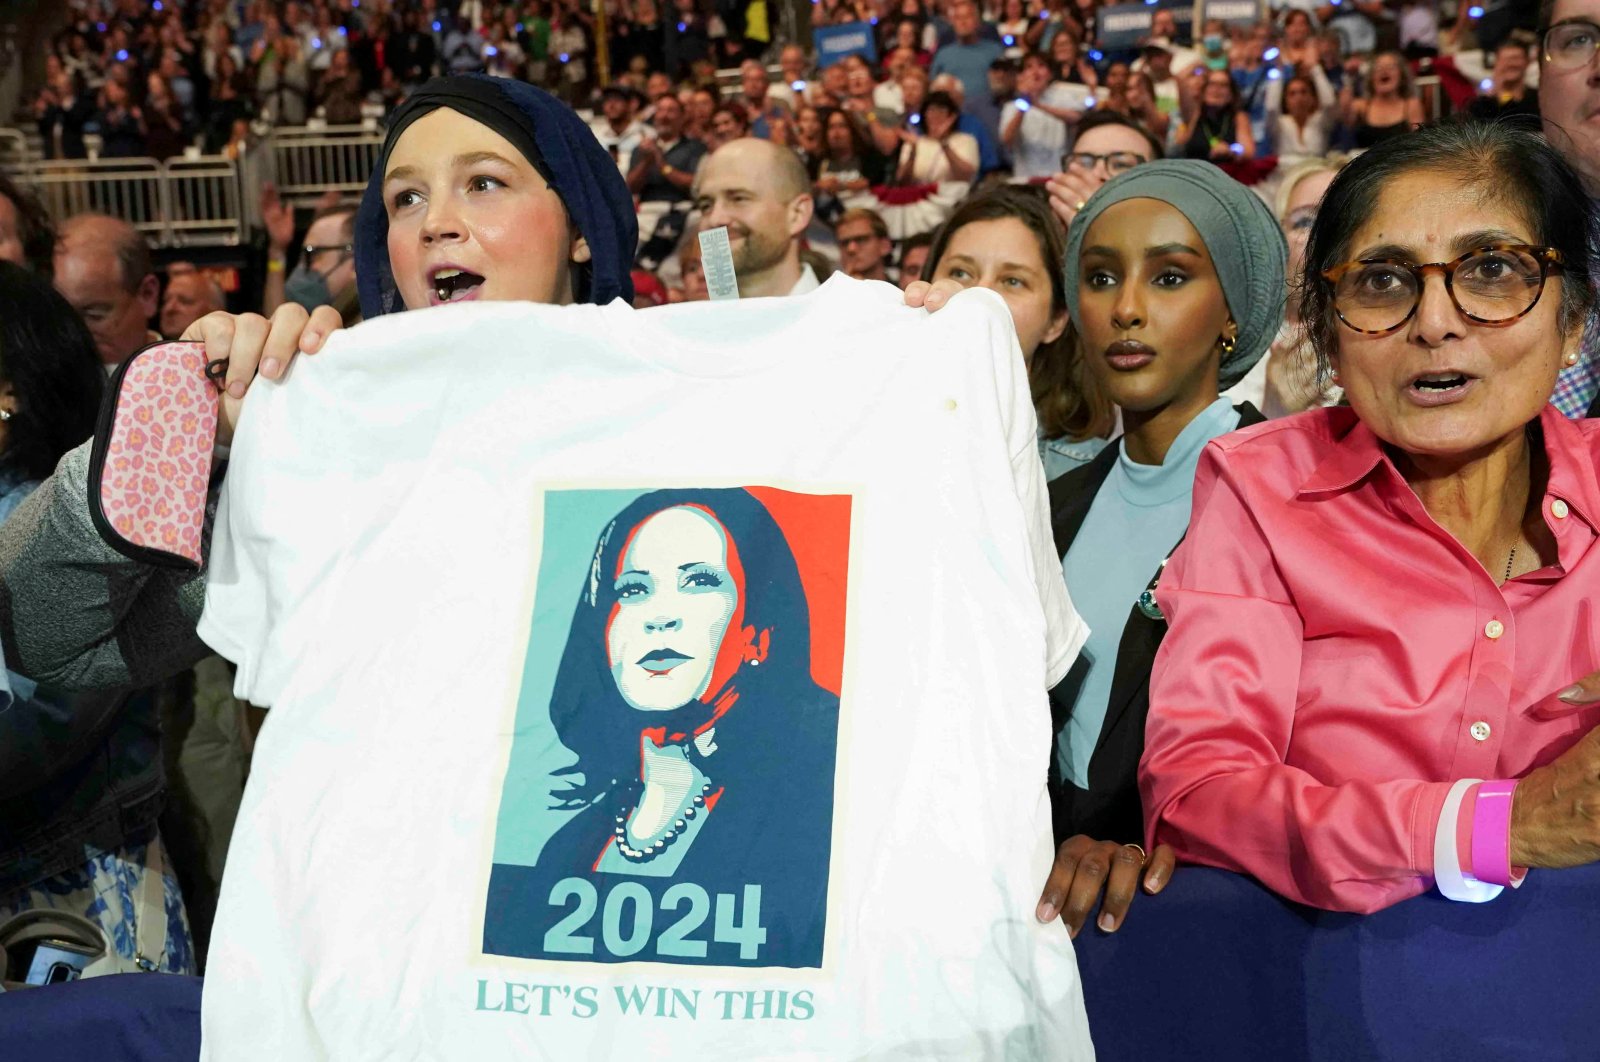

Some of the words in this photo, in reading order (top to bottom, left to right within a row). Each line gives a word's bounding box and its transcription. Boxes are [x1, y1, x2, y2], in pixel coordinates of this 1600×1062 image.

[543, 876, 767, 960] 2024
[475, 979, 599, 1018] LET'S
[613, 984, 702, 1021] WIN
[713, 989, 815, 1021] THIS
